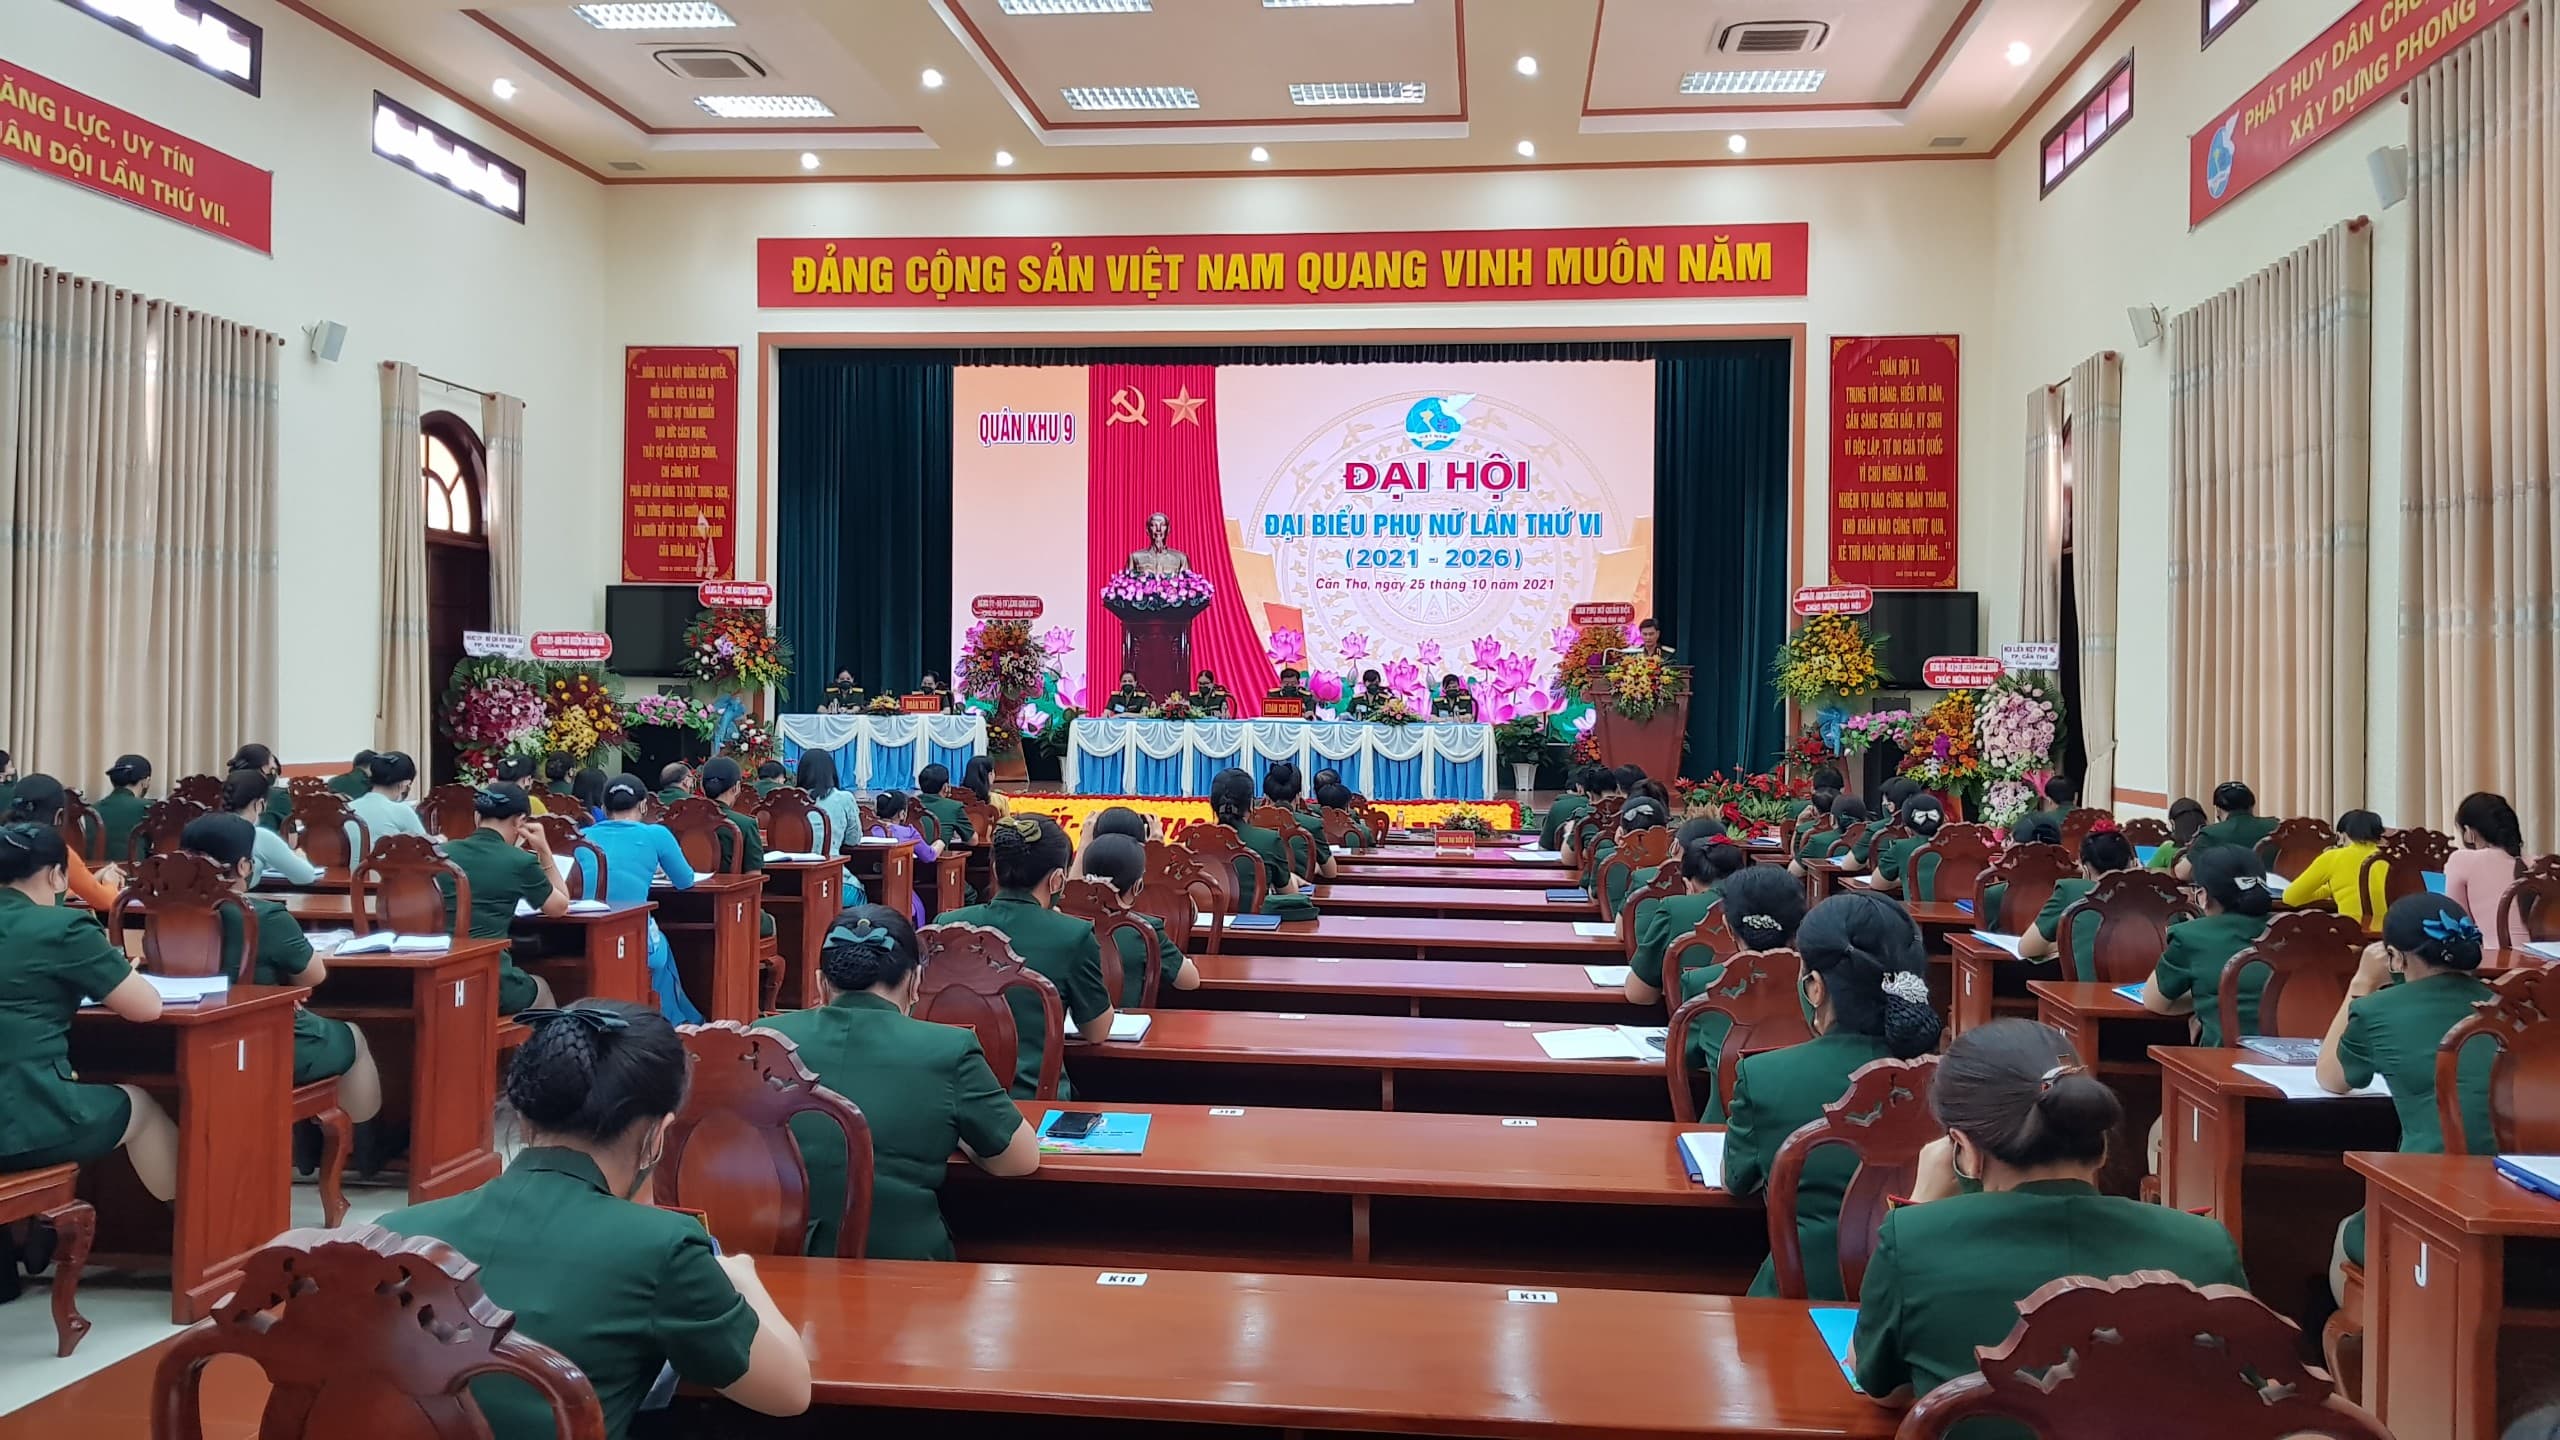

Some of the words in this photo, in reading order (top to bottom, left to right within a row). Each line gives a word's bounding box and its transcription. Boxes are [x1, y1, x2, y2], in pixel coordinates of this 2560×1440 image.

[2245, 81, 2287, 136] PHÁT
[2290, 51, 2328, 102] HUY
[2332, 26, 2374, 71] DÂN
[2288, 98, 2328, 147] XÂY
[2332, 53, 2388, 113] DỰNG
[2395, 0, 2477, 72] PHONG
[64, 106, 116, 148] LỰC,
[123, 130, 154, 160] UY
[160, 144, 194, 177] TÍN
[0, 119, 42, 158] ÂN
[49, 140, 92, 178] ĐỘI
[100, 158, 145, 196] LẦN
[151, 179, 195, 213] THỨ
[200, 198, 231, 228] VII.
[792, 243, 893, 294] ĐẢNG
[906, 249, 1006, 300] CỘNG
[1018, 242, 1095, 293] SẢN
[1106, 246, 1185, 300] VIỆT
[1198, 252, 1285, 292] NAM
[1298, 250, 1427, 294] QUANG
[1442, 248, 1533, 288] VINH
[1547, 238, 1665, 286] MUÔN
[1678, 233, 1773, 283] NĂM
[980, 407, 1021, 445] QUÂN
[1027, 413, 1059, 442] KHU
[1064, 413, 1073, 442] 9
[1343, 462, 1429, 501] ĐẠI
[1446, 453, 1529, 501] HỘI
[1264, 514, 1305, 542] ĐẠI
[1312, 504, 1365, 537] BIỂU
[1373, 514, 1421, 541] PHỤ
[1429, 508, 1467, 537] NỮ
[1470, 504, 1517, 537] LẦN
[1526, 505, 1577, 537] THỨ
[1579, 513, 1602, 537] VI
[1346, 549, 1418, 569] (2021
[1445, 549, 1523, 569] 2026)
[1409, 578, 1426, 590] 25
[1430, 577, 1466, 593] tháng
[1472, 578, 1487, 590] 10
[1522, 578, 1554, 590] 2021
[822, 880, 829, 898] E
[737, 902, 744, 923] F
[617, 935, 625, 959] G
[455, 979, 465, 1009] H
[1108, 1275, 1137, 1283] K10
[2414, 1241, 2428, 1288] J
[1520, 1293, 1546, 1301] K11
